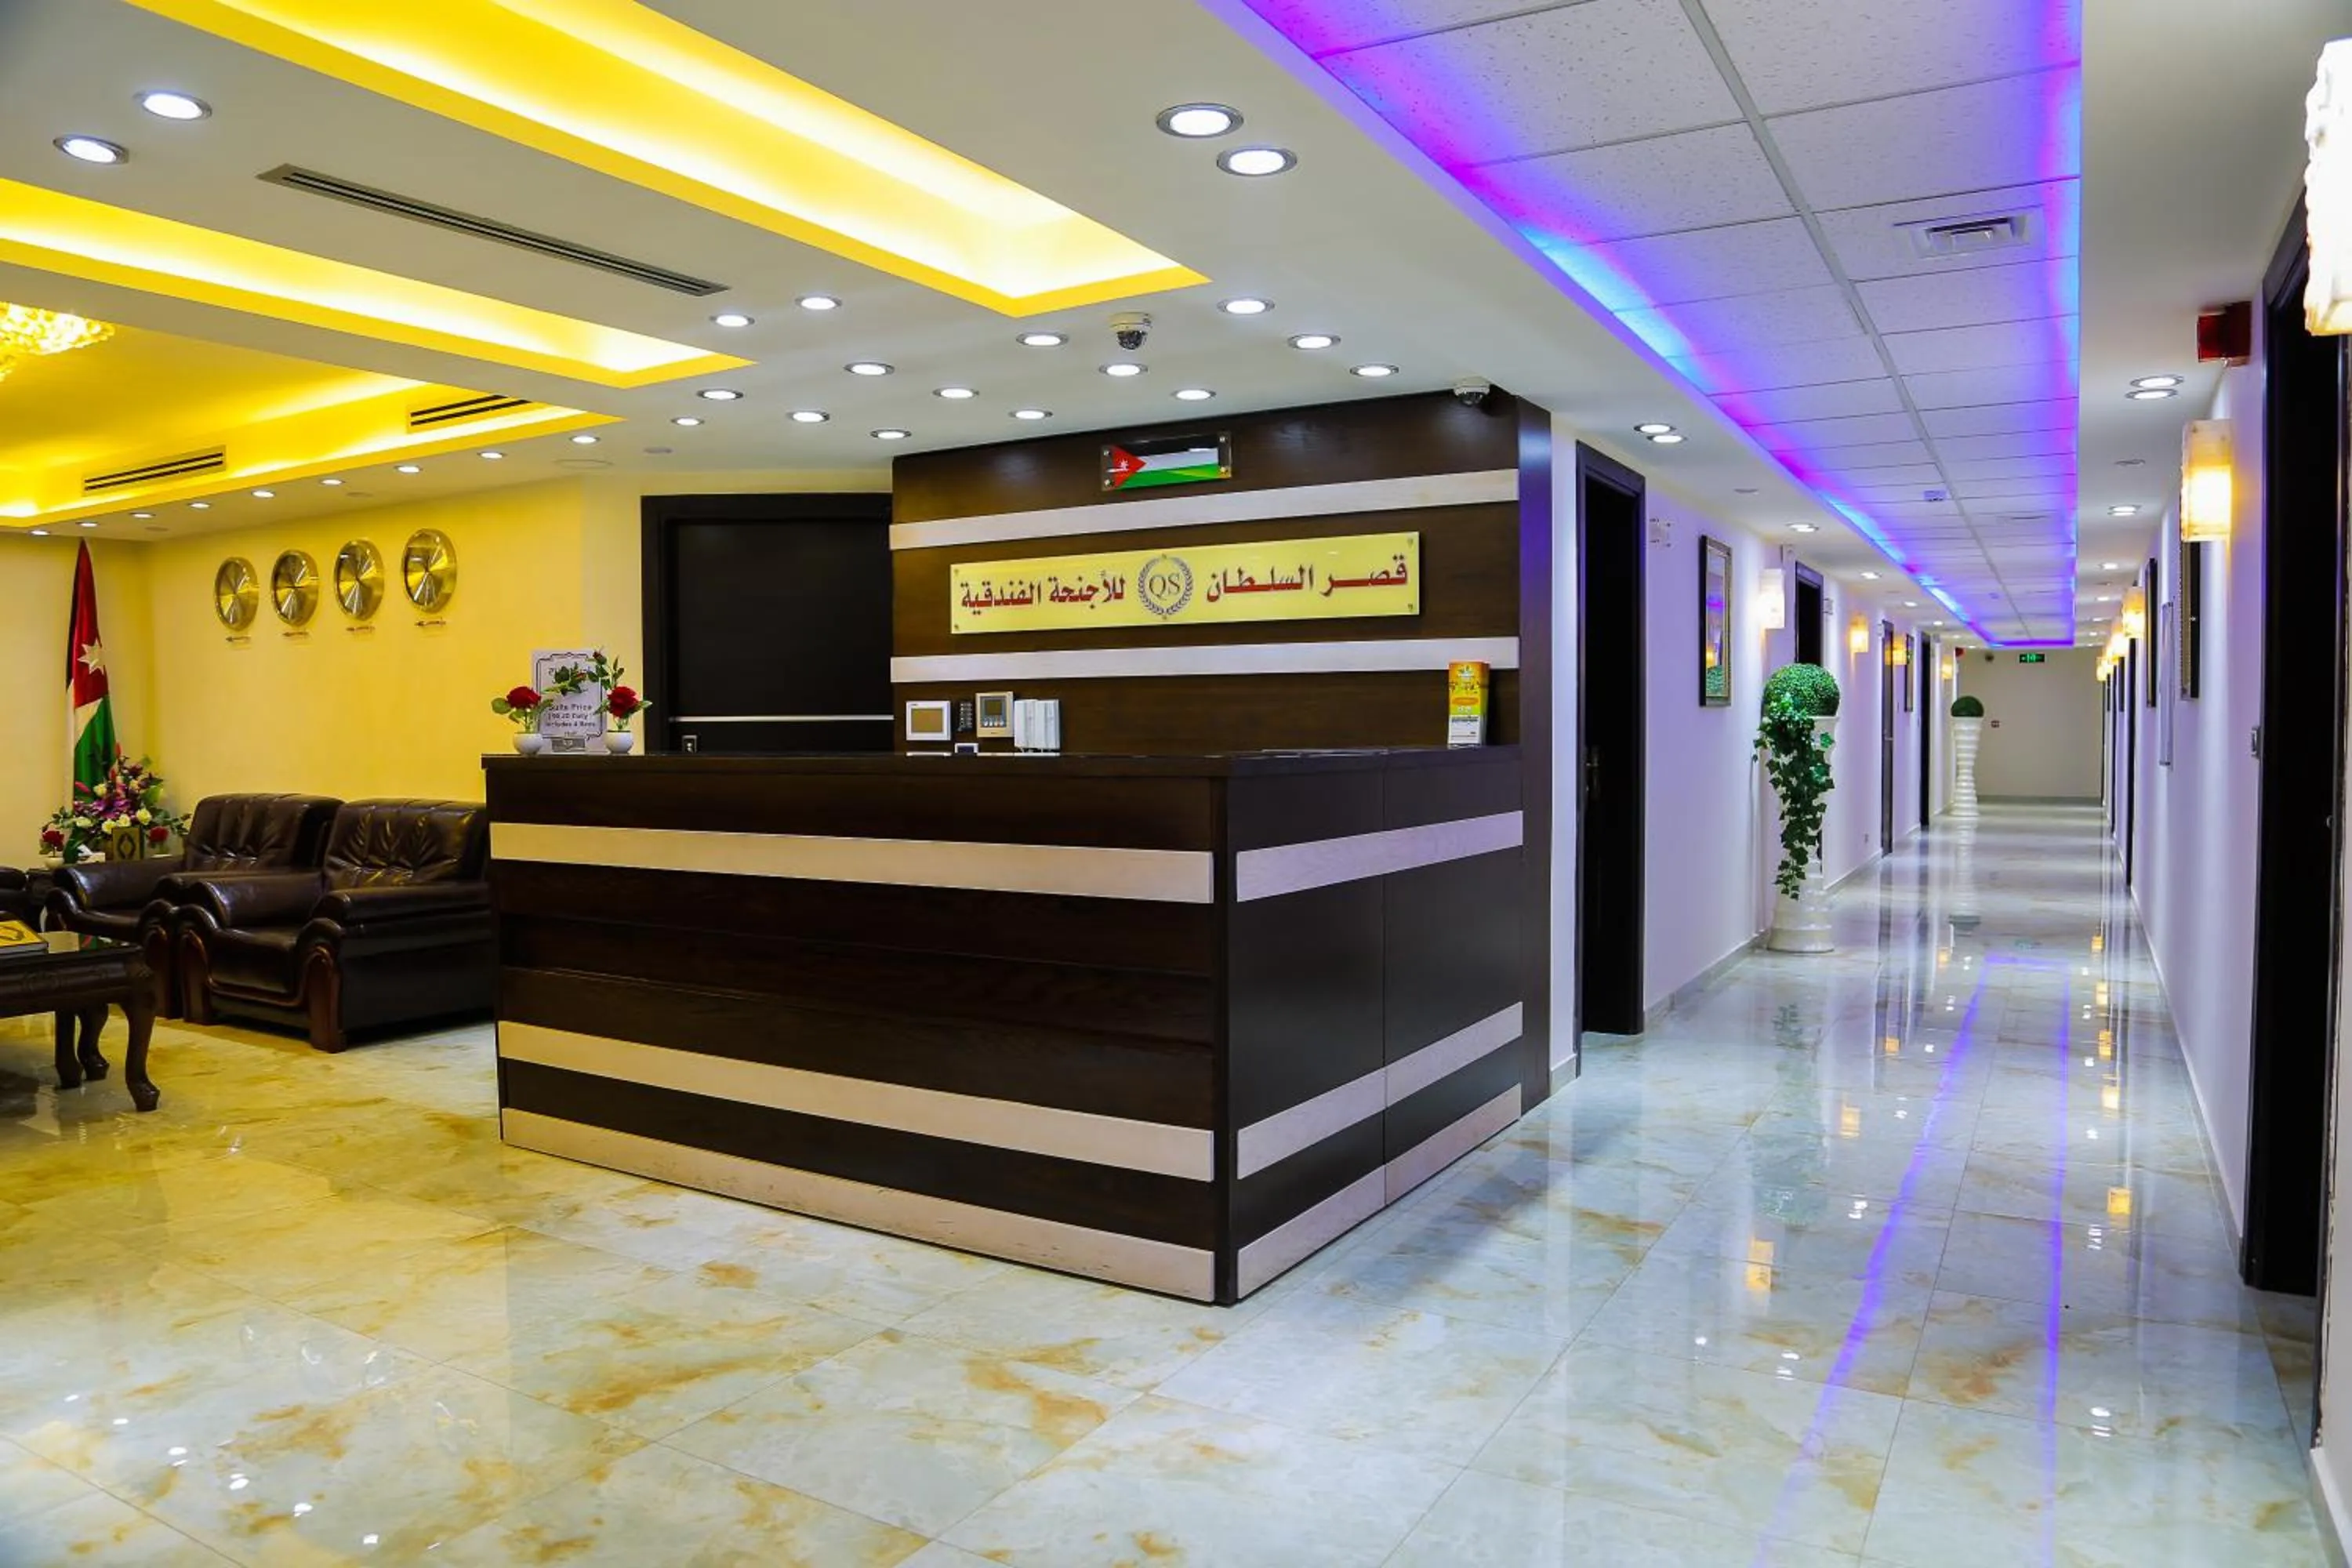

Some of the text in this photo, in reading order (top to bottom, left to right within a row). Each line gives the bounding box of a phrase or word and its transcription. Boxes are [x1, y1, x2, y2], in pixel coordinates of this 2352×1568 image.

[1149, 572, 1182, 601] QS
[1207, 563, 1315, 602] السلطان
[1319, 554, 1408, 597] قصر
[960, 579, 1042, 615] الفندقية
